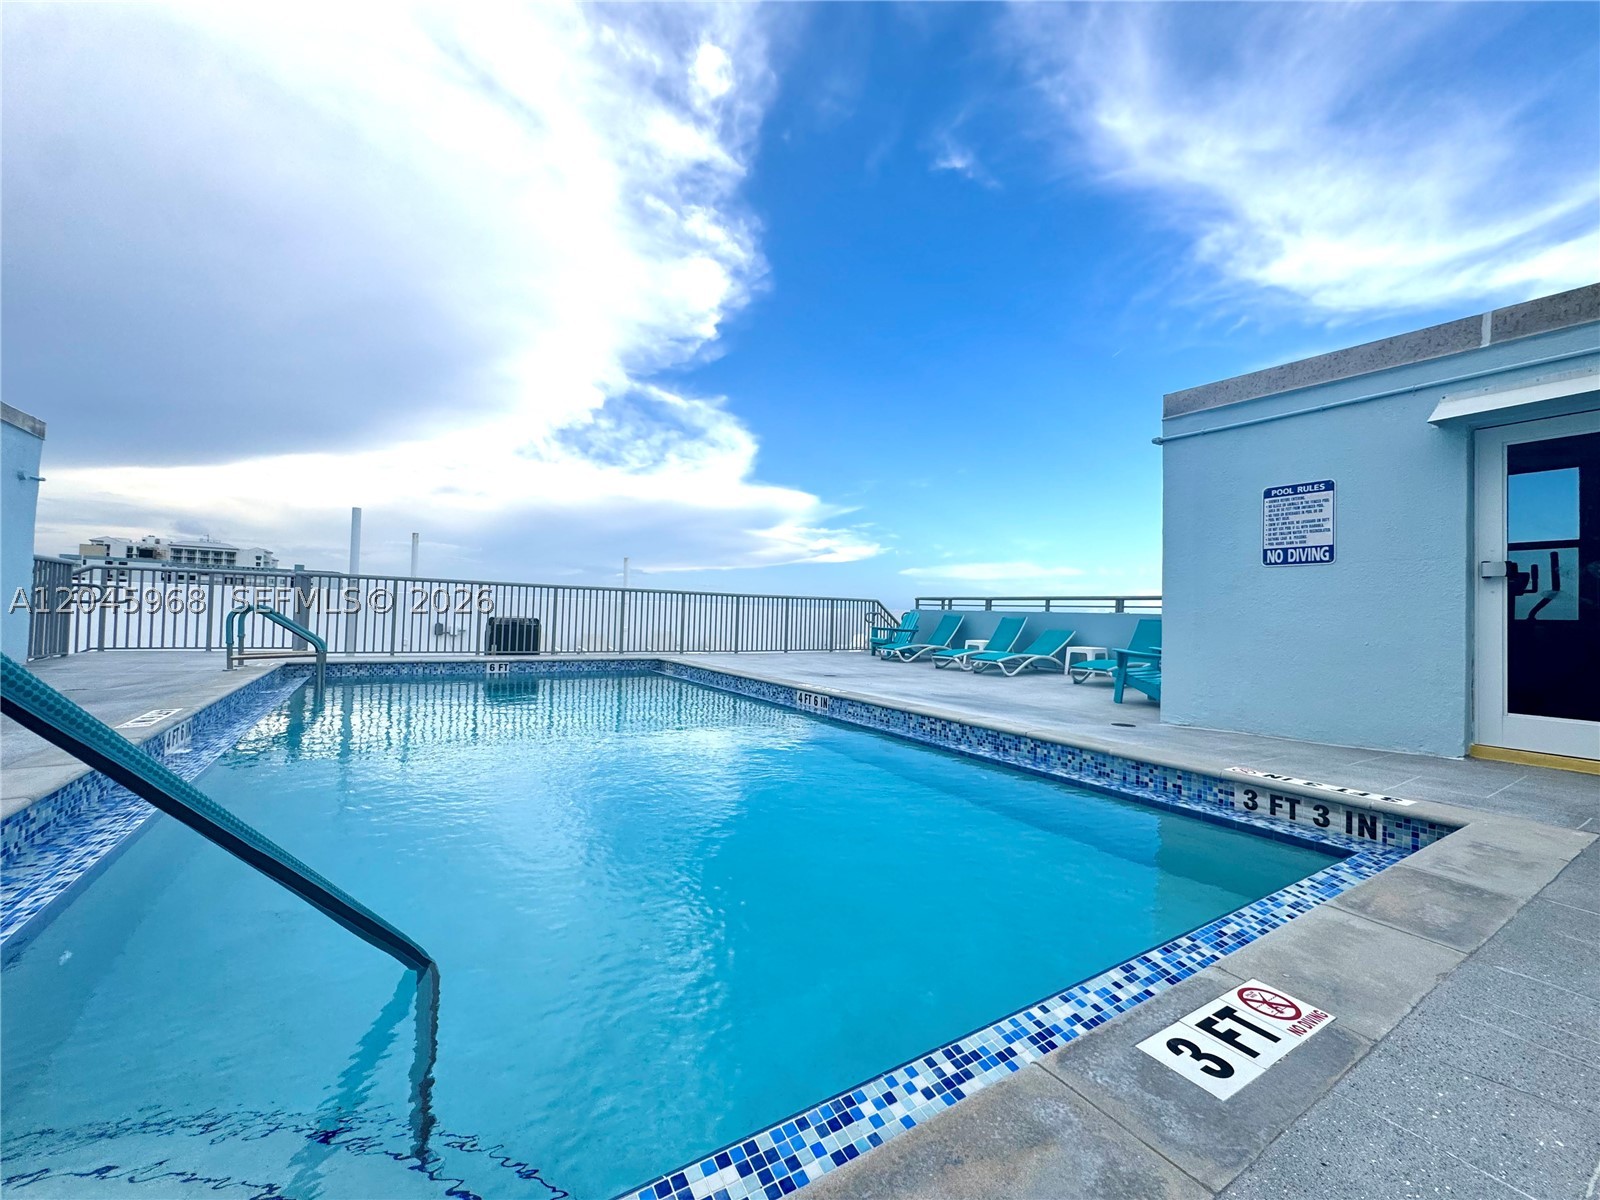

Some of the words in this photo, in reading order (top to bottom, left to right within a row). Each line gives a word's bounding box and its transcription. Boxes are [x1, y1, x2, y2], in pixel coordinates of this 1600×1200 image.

[1271, 487, 1294, 496] POOL
[1297, 483, 1326, 493] RULES
[1266, 549, 1284, 563] NO
[1287, 546, 1330, 562] DIVING
[489, 663, 496, 671] 6
[498, 663, 508, 671] FT
[798, 692, 803, 703] 4
[804, 693, 812, 704] FT
[813, 695, 819, 706] 6
[820, 697, 828, 708] IN
[1243, 789, 1258, 811] 3
[1269, 793, 1301, 820] FT
[1312, 804, 1331, 828] 3
[1345, 810, 1378, 841] IN
[1194, 1005, 1282, 1059] FT
[1286, 1024, 1308, 1037] NO
[1297, 1010, 1328, 1029] DIVING
[1166, 1037, 1235, 1079] 3
